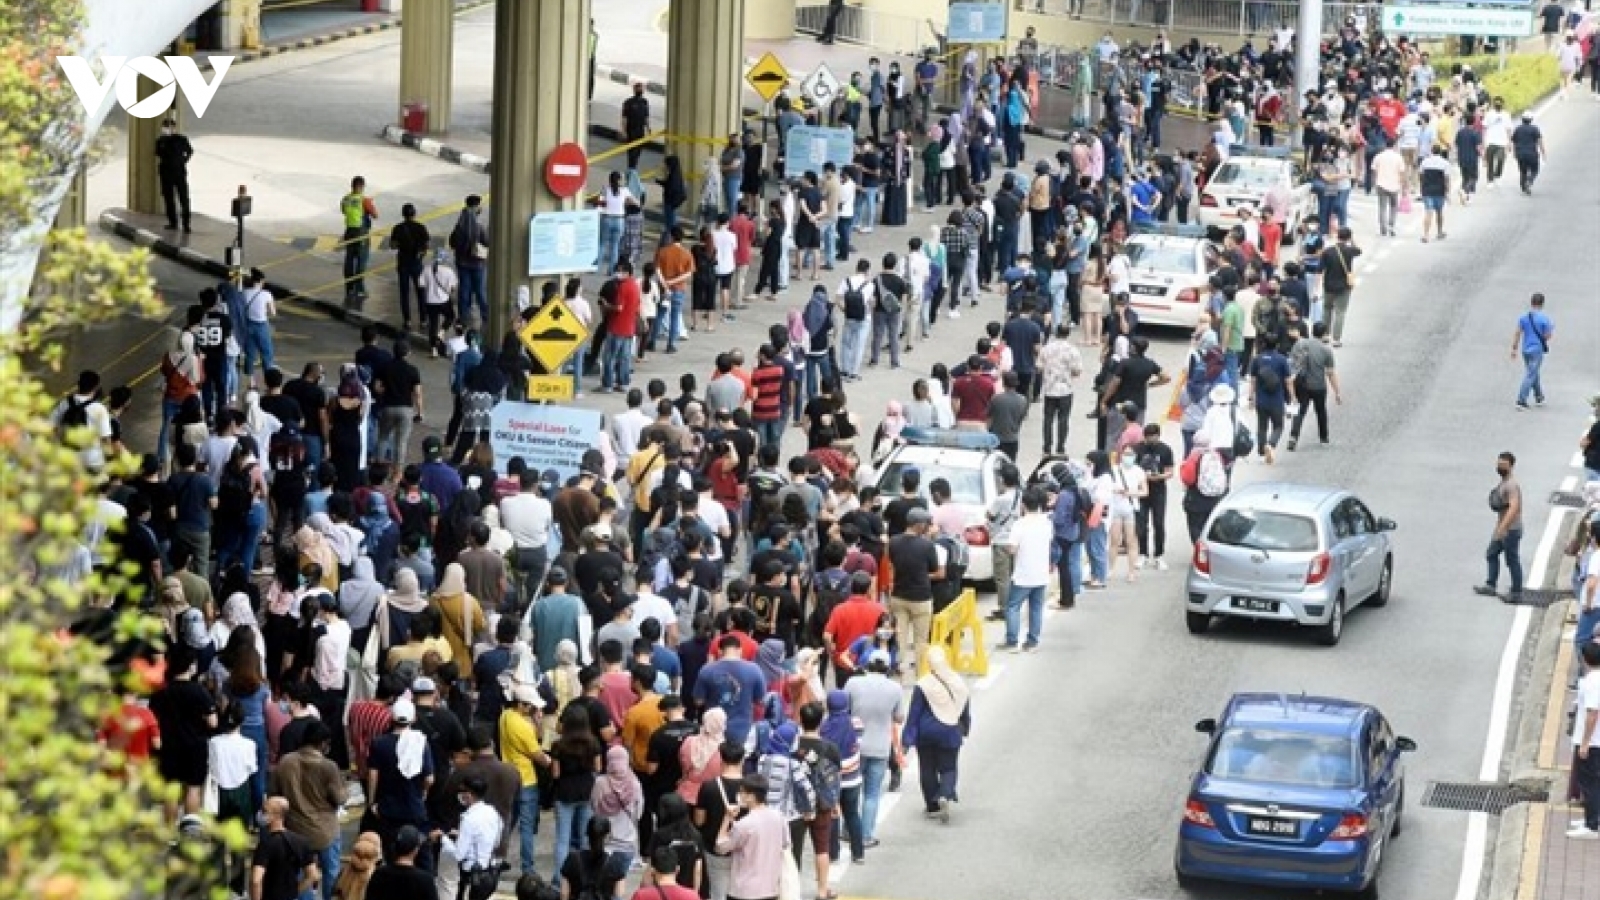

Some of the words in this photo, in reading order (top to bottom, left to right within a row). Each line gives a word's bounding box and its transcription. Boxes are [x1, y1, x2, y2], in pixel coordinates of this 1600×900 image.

[508, 418, 543, 432] Special
[544, 423, 567, 434] Lane
[568, 425, 582, 435] for
[494, 430, 516, 441] OKU
[517, 433, 525, 443] &
[526, 433, 556, 445] Senior
